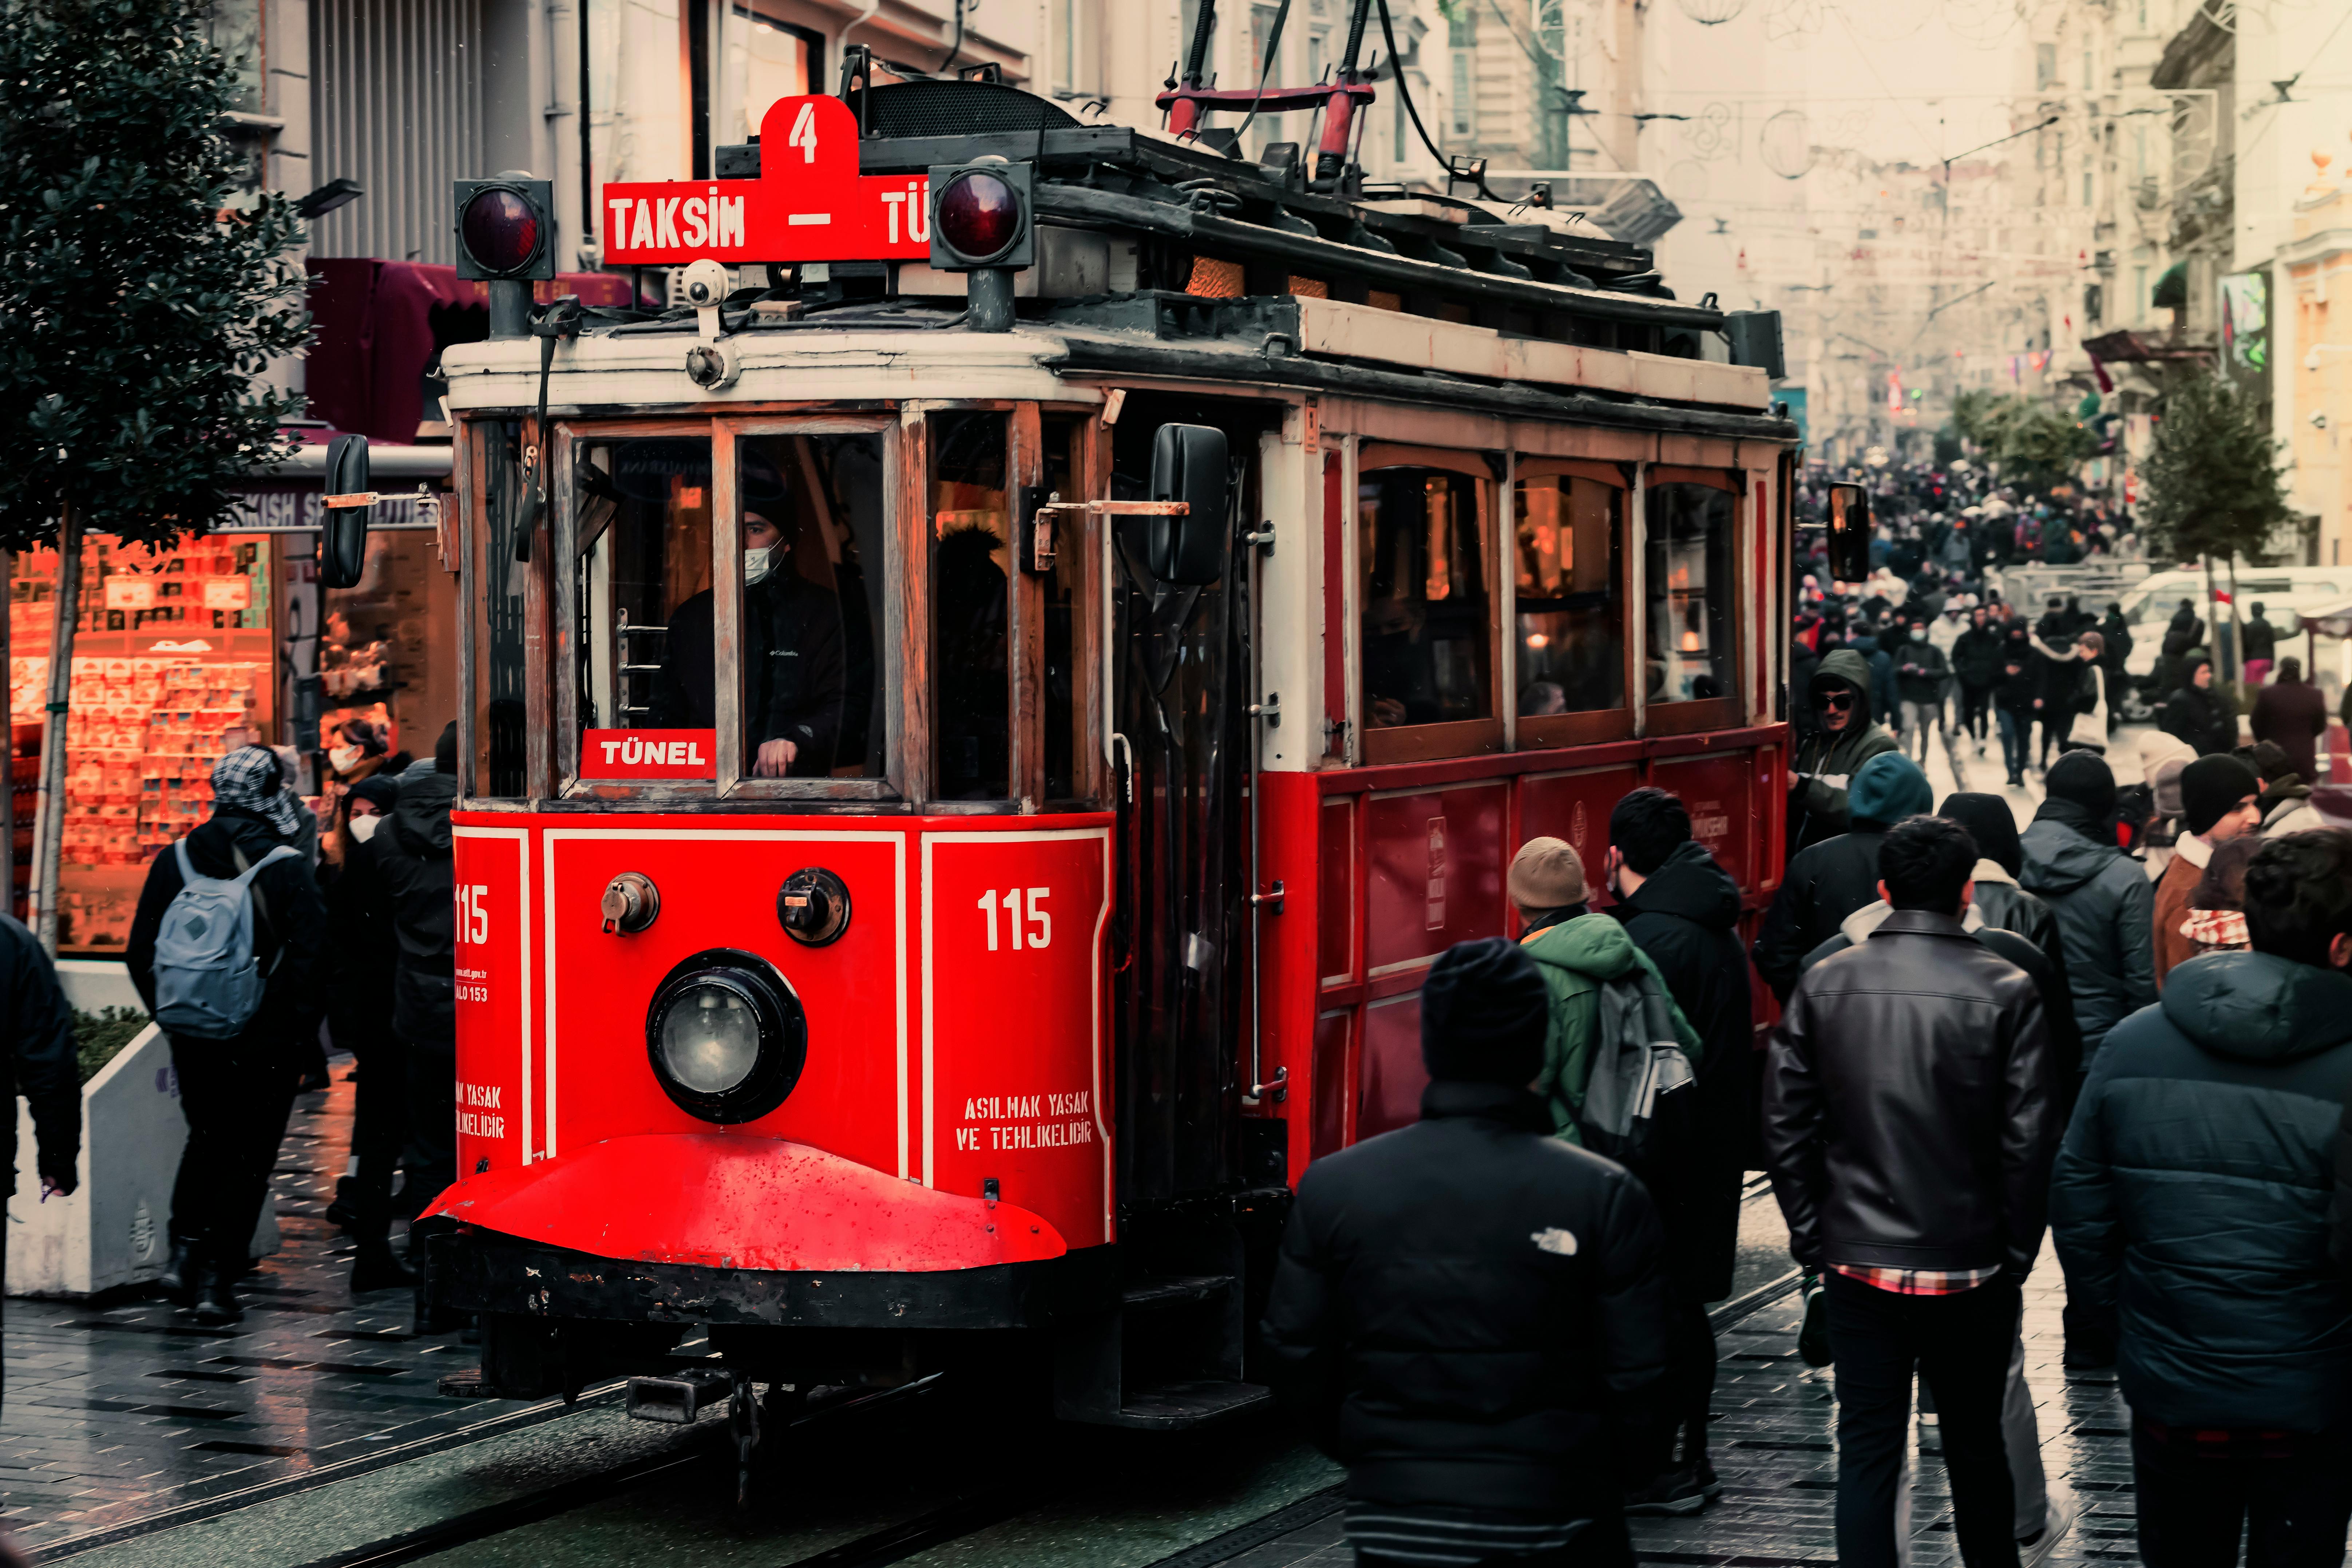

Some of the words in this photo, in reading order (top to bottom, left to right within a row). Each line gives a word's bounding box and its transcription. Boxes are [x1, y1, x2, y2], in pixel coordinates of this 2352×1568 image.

[789, 103, 817, 164] 4
[609, 186, 744, 250] TAKSİM
[881, 181, 930, 243] TÜ
[601, 737, 705, 765] TÜNEL
[455, 884, 488, 945] 115
[978, 887, 1051, 951] 115
[470, 987, 488, 1002] 153
[467, 1083, 501, 1109] YASAK
[1048, 1090, 1088, 1116] YASAK
[956, 1128, 980, 1151] VE
[990, 1118, 1091, 1150] TEHLİKELİDİR
